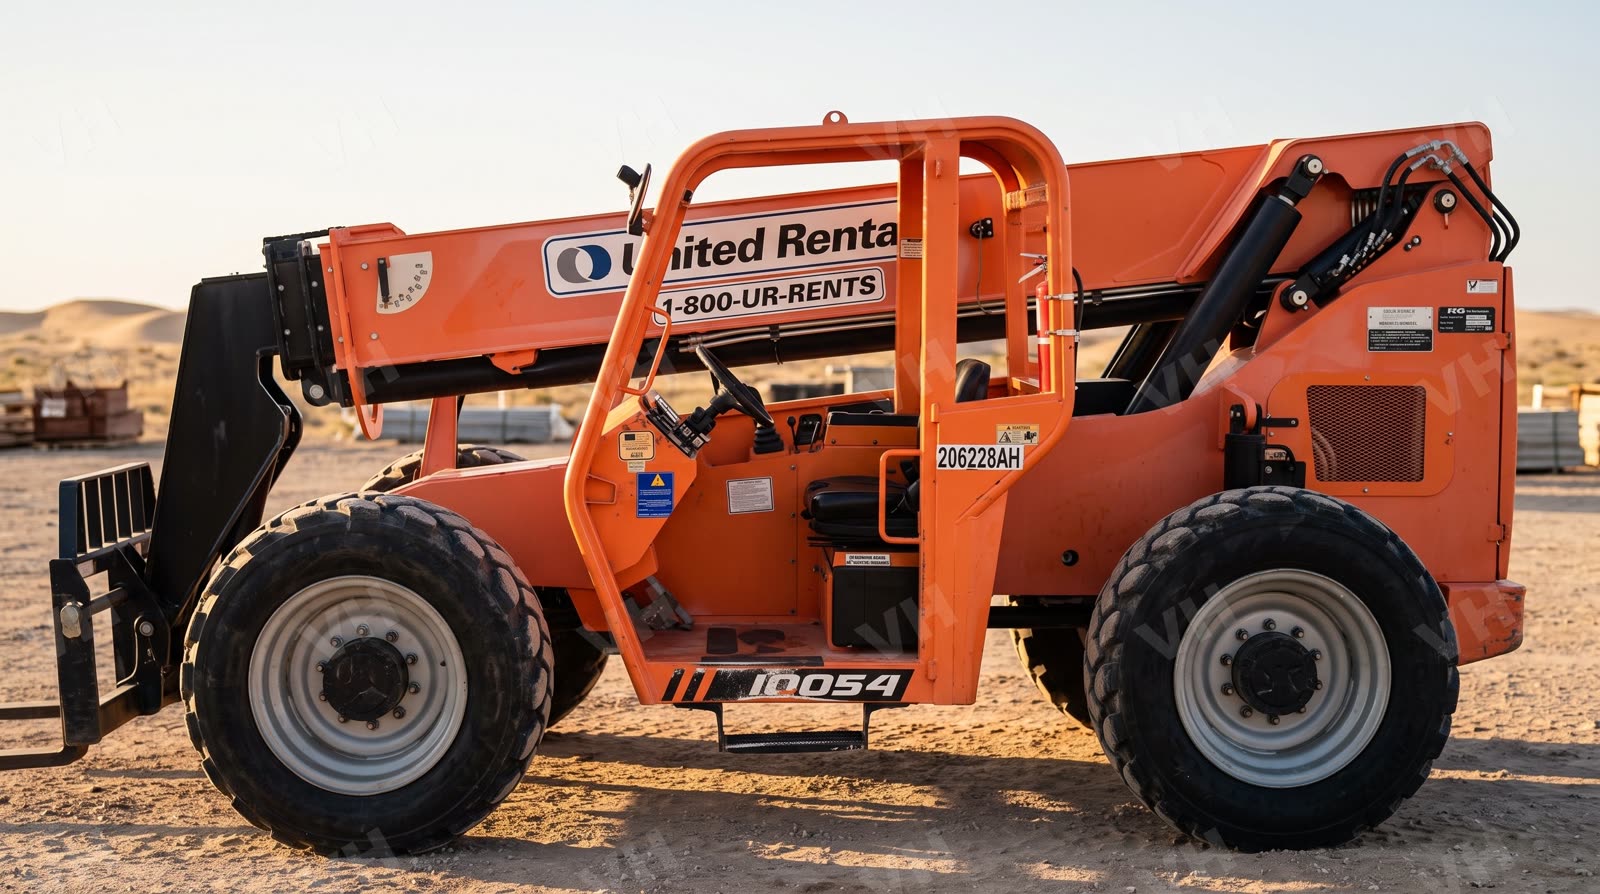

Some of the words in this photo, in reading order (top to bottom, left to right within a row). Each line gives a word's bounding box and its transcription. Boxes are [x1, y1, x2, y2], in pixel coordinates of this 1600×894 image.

[776, 218, 898, 259] Renta
[661, 275, 876, 317] 1-800-UR-RENTS
[938, 446, 1020, 469] 206228AH
[749, 673, 901, 698] 10054
